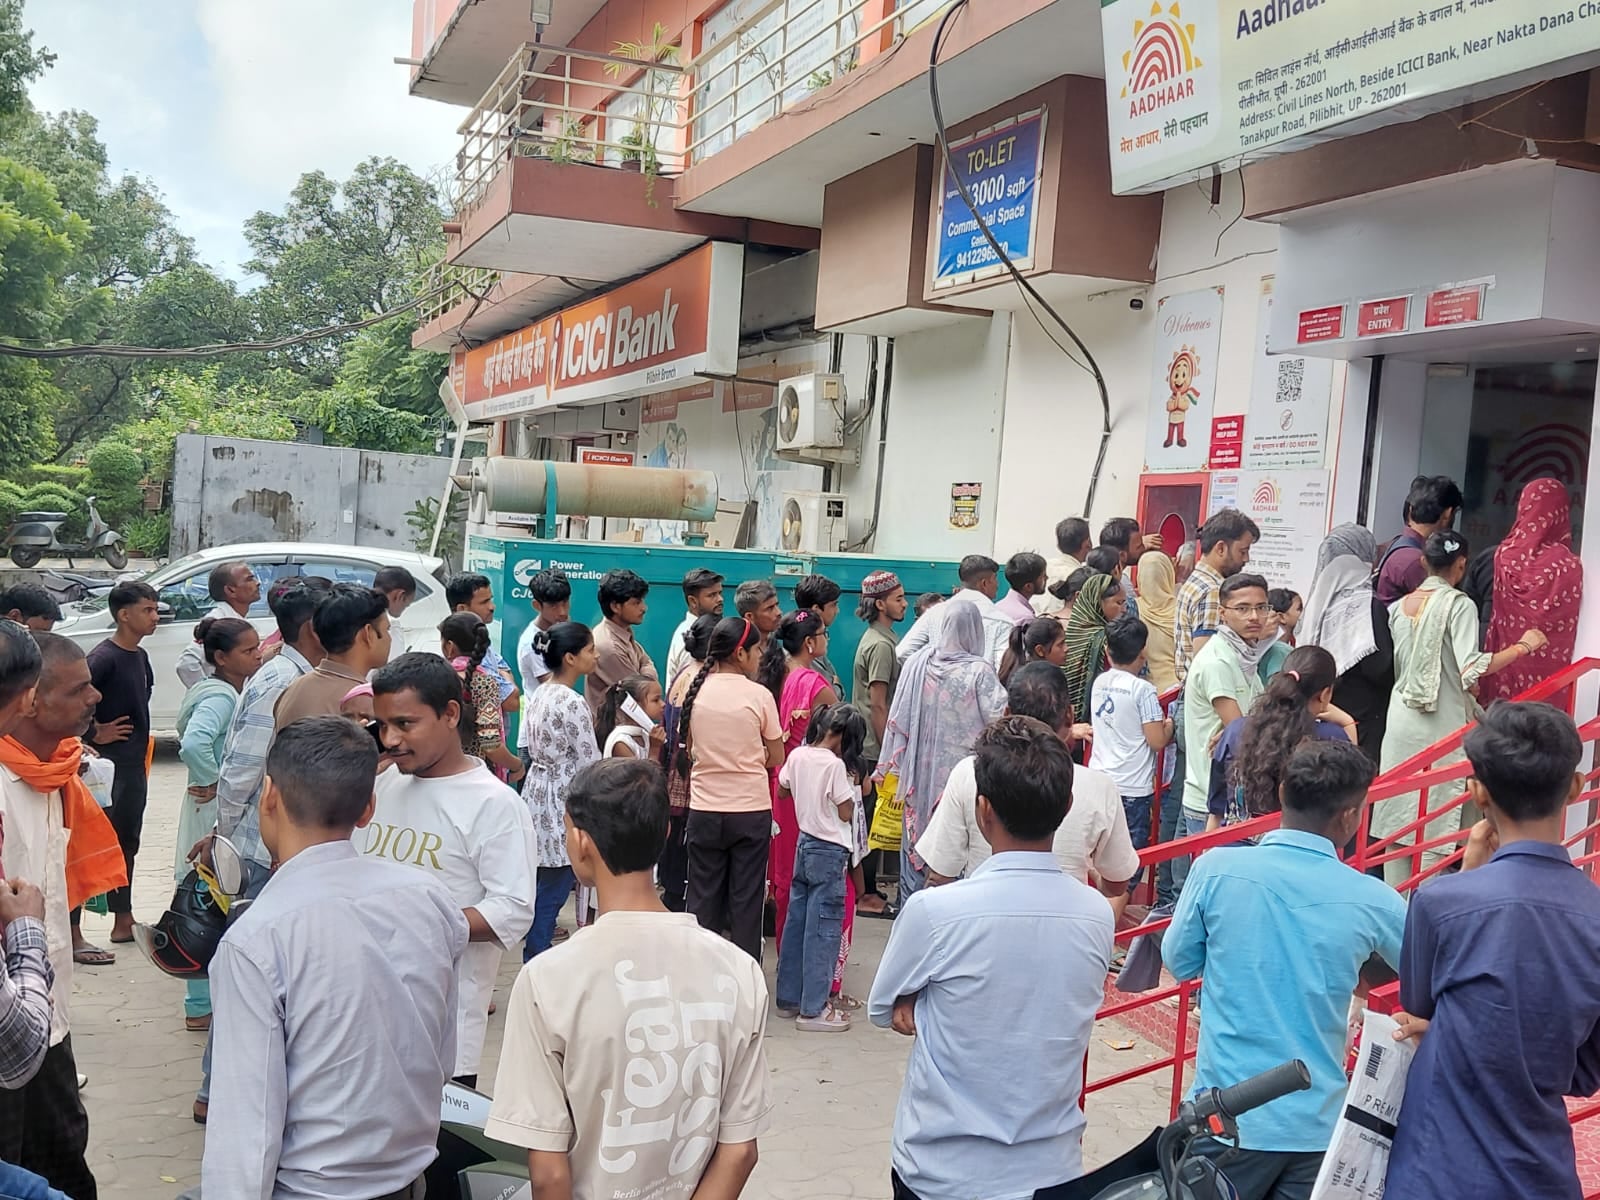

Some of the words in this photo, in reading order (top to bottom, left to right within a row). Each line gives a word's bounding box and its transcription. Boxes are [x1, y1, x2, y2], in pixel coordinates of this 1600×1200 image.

[1238, 79, 1254, 92] पता:
[1255, 68, 1279, 86] सिविल
[1398, 15, 1415, 33] बैंक
[1417, 10, 1427, 27] के
[1429, 4, 1453, 22] बगल
[1239, 108, 1276, 129] Address:
[1277, 97, 1297, 116] Civil
[1299, 89, 1323, 109] Lines
[1326, 78, 1357, 100] North,
[1360, 66, 1394, 88] Beside
[1397, 55, 1424, 77] ICICI
[1427, 45, 1460, 67] Bank,
[1463, 35, 1494, 56] Near
[1497, 22, 1536, 45] Nakta
[1539, 10, 1574, 32] Dana
[1273, 82, 1288, 101] यूपी
[1295, 69, 1327, 91] 262001
[1129, 78, 1194, 119] AADHAAR
[1239, 126, 1279, 147] Tanakpur
[1282, 115, 1307, 133] Road,
[1309, 103, 1345, 125] Pilibhit,
[1348, 95, 1362, 112] UP
[1370, 82, 1407, 105] 262001
[1120, 137, 1133, 153] मेरा
[1135, 129, 1162, 149] आधार,
[1164, 118, 1178, 139] मेरी
[1180, 112, 1208, 134] पहचान
[967, 136, 1017, 175] TO-LET
[971, 173, 1005, 207] 3000
[1006, 176, 1026, 199] sqft
[997, 204, 1025, 226] Space
[1367, 317, 1393, 331] ENTRY
[1373, 303, 1390, 316] प्रवेश
[561, 313, 614, 381] ICICI
[612, 287, 680, 368] Bank
[550, 560, 584, 570] Power
[364, 822, 443, 870] DIOR
[441, 1092, 470, 1111] hwa
[503, 1185, 515, 1197] Pro
